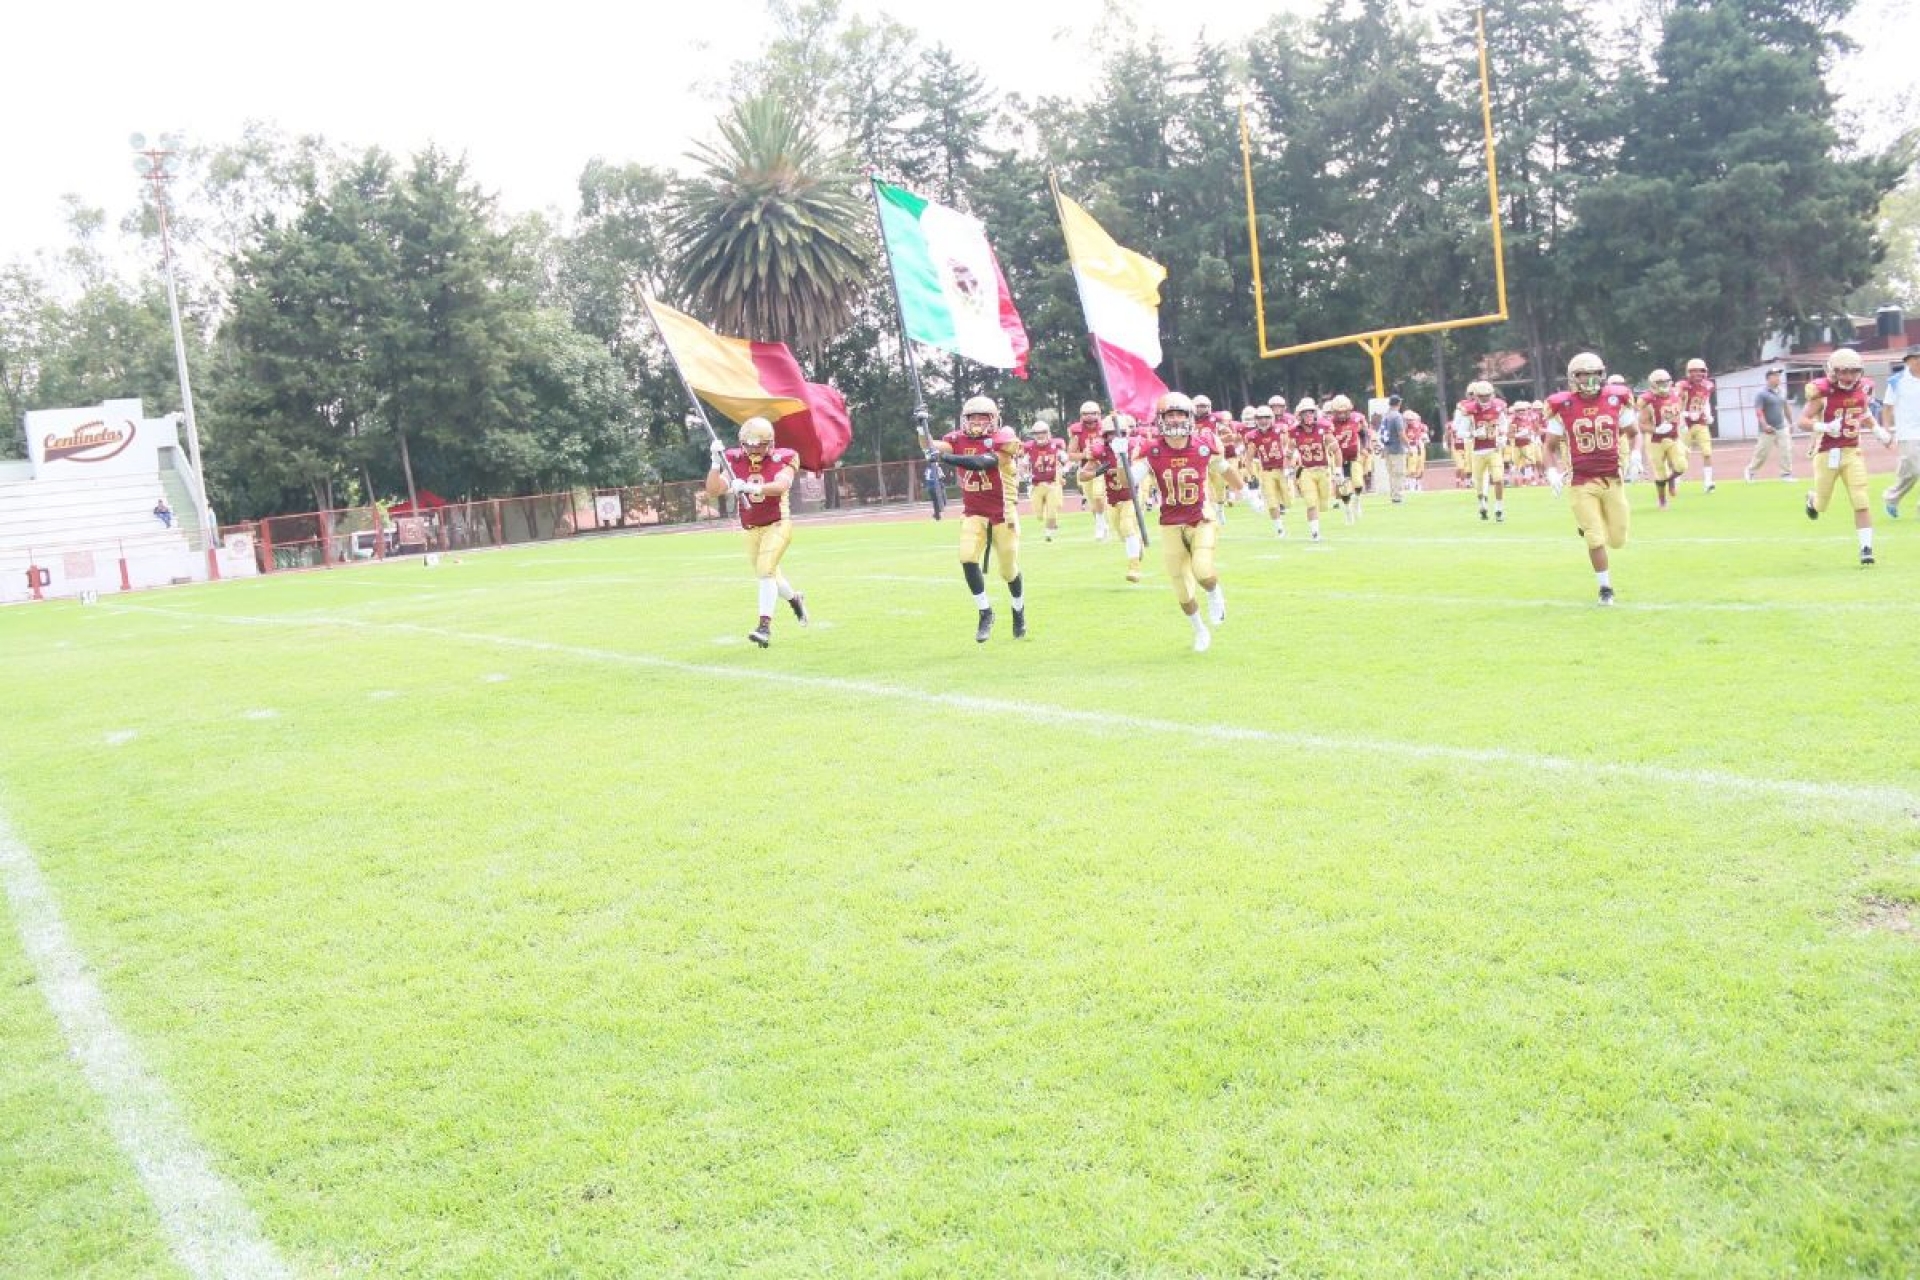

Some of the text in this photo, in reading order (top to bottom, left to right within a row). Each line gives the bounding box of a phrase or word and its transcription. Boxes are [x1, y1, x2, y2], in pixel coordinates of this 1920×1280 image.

[1299, 442, 1323, 462] 33
[1573, 415, 1614, 453] 66
[1163, 469, 1199, 505] 16
